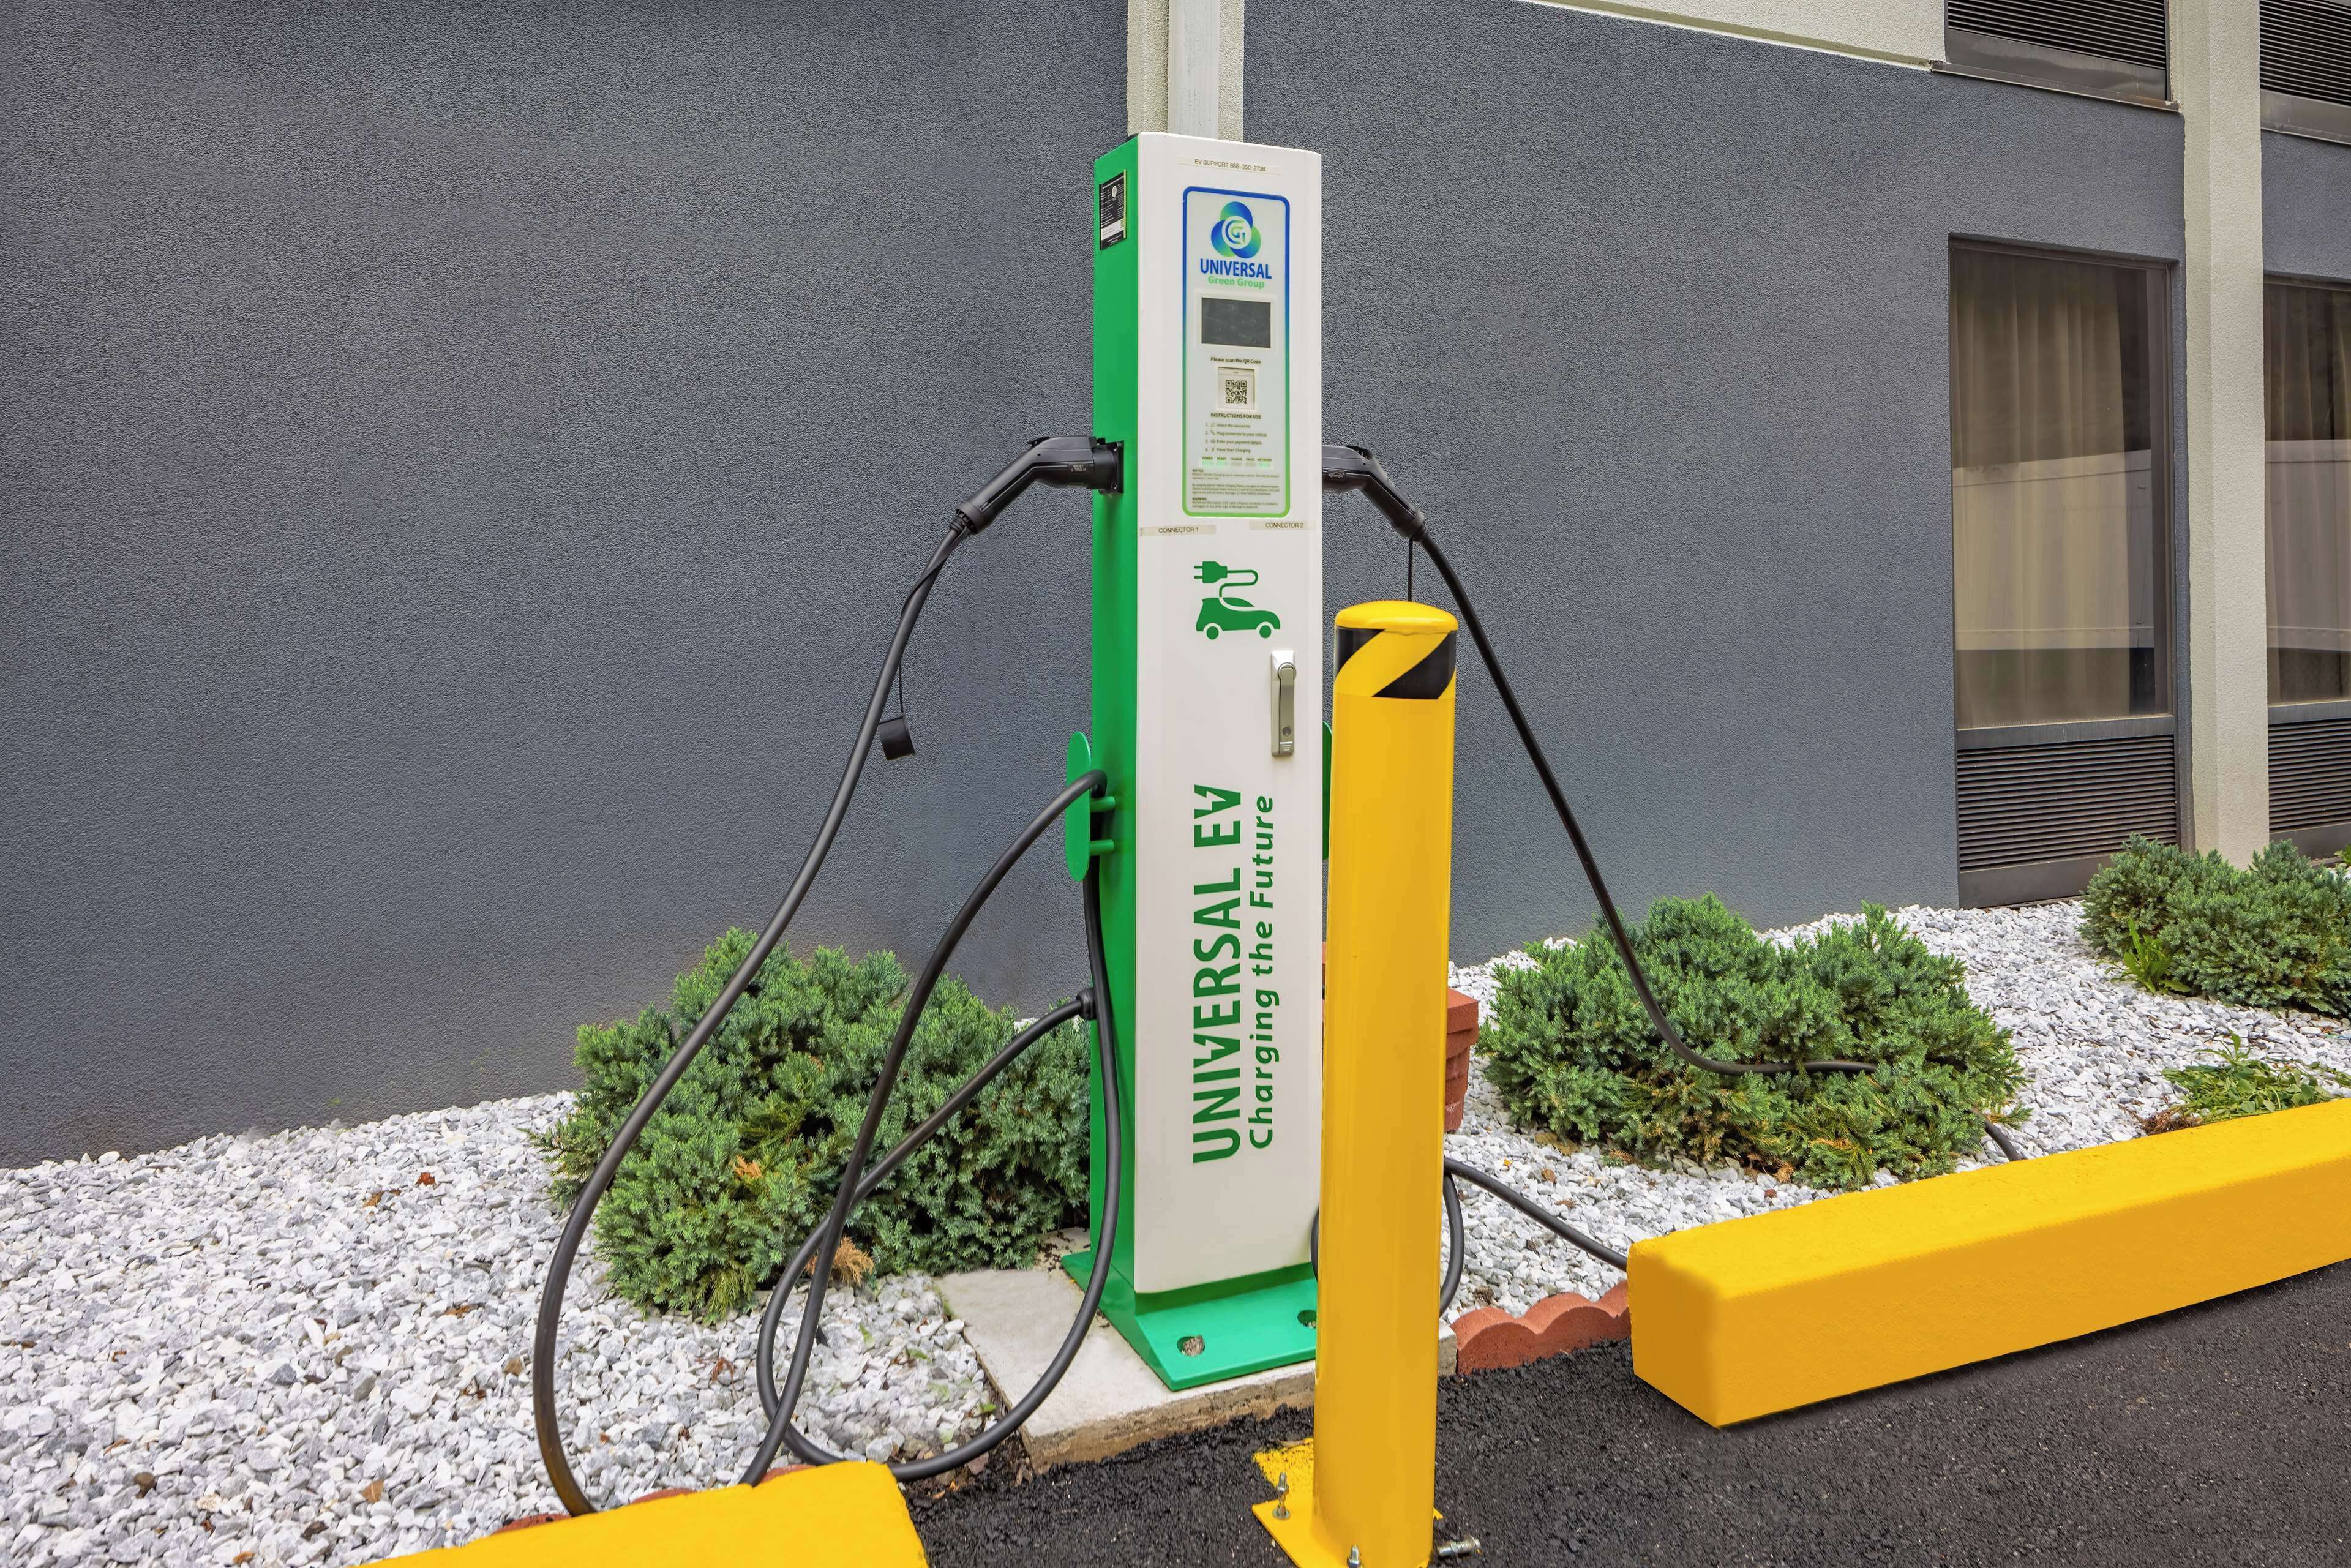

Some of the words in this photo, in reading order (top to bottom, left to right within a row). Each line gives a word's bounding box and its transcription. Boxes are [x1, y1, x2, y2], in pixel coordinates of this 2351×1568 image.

[1200, 258, 1272, 279] UNIVERSAL
[1207, 276, 1235, 285] Green
[1237, 277, 1265, 289] Group
[1193, 784, 1242, 848] EV
[1250, 795, 1273, 909] Future
[1248, 921, 1273, 977] the
[1193, 866, 1241, 1164] UNIVERSAL
[1248, 988, 1280, 1149] Charging
